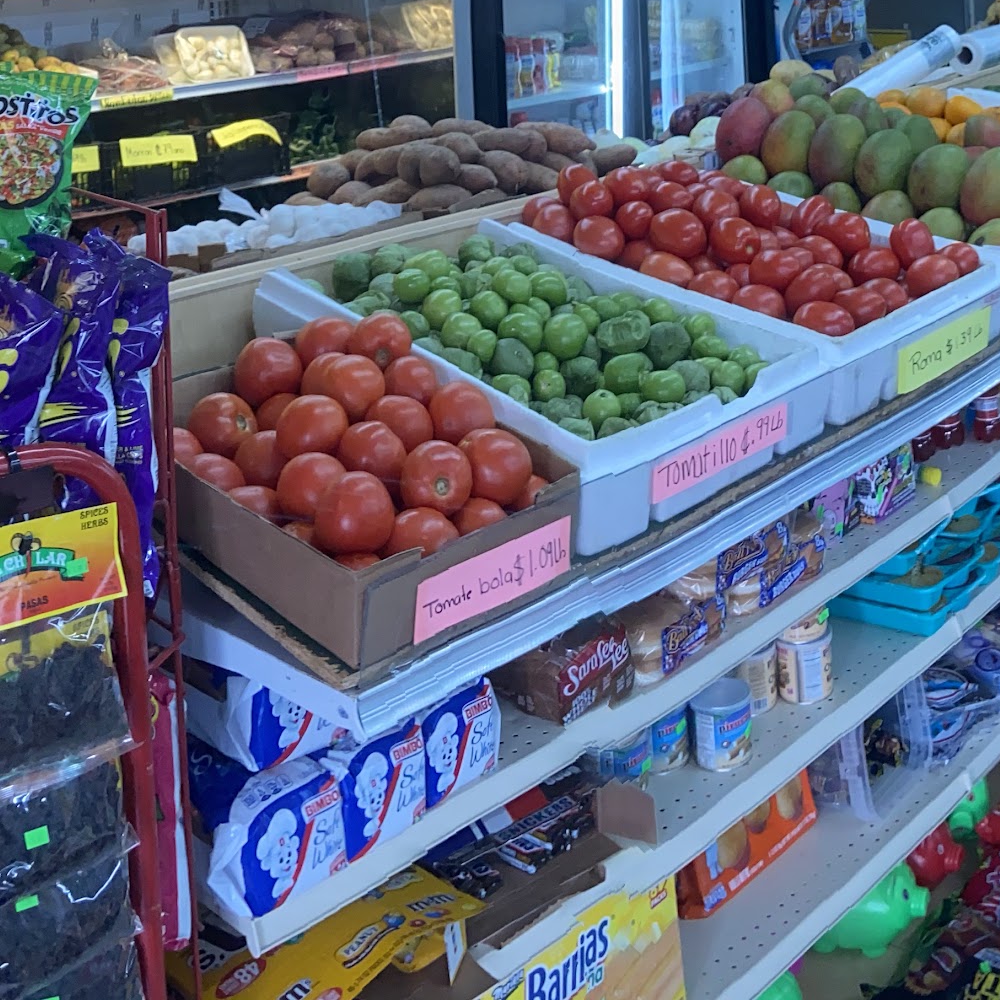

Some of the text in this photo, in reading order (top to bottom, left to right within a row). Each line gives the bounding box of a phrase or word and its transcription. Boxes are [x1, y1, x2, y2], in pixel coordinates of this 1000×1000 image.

[80, 506, 109, 520] SPICES
[81, 517, 109, 531] HERBS
[422, 584, 472, 618] Tomate
[465, 696, 492, 720] BIMBO
[392, 738, 423, 761] BIMBO
[304, 790, 340, 816] BIMBO
[497, 795, 574, 842] SNICKERS
[343, 925, 379, 956] PEANUT
